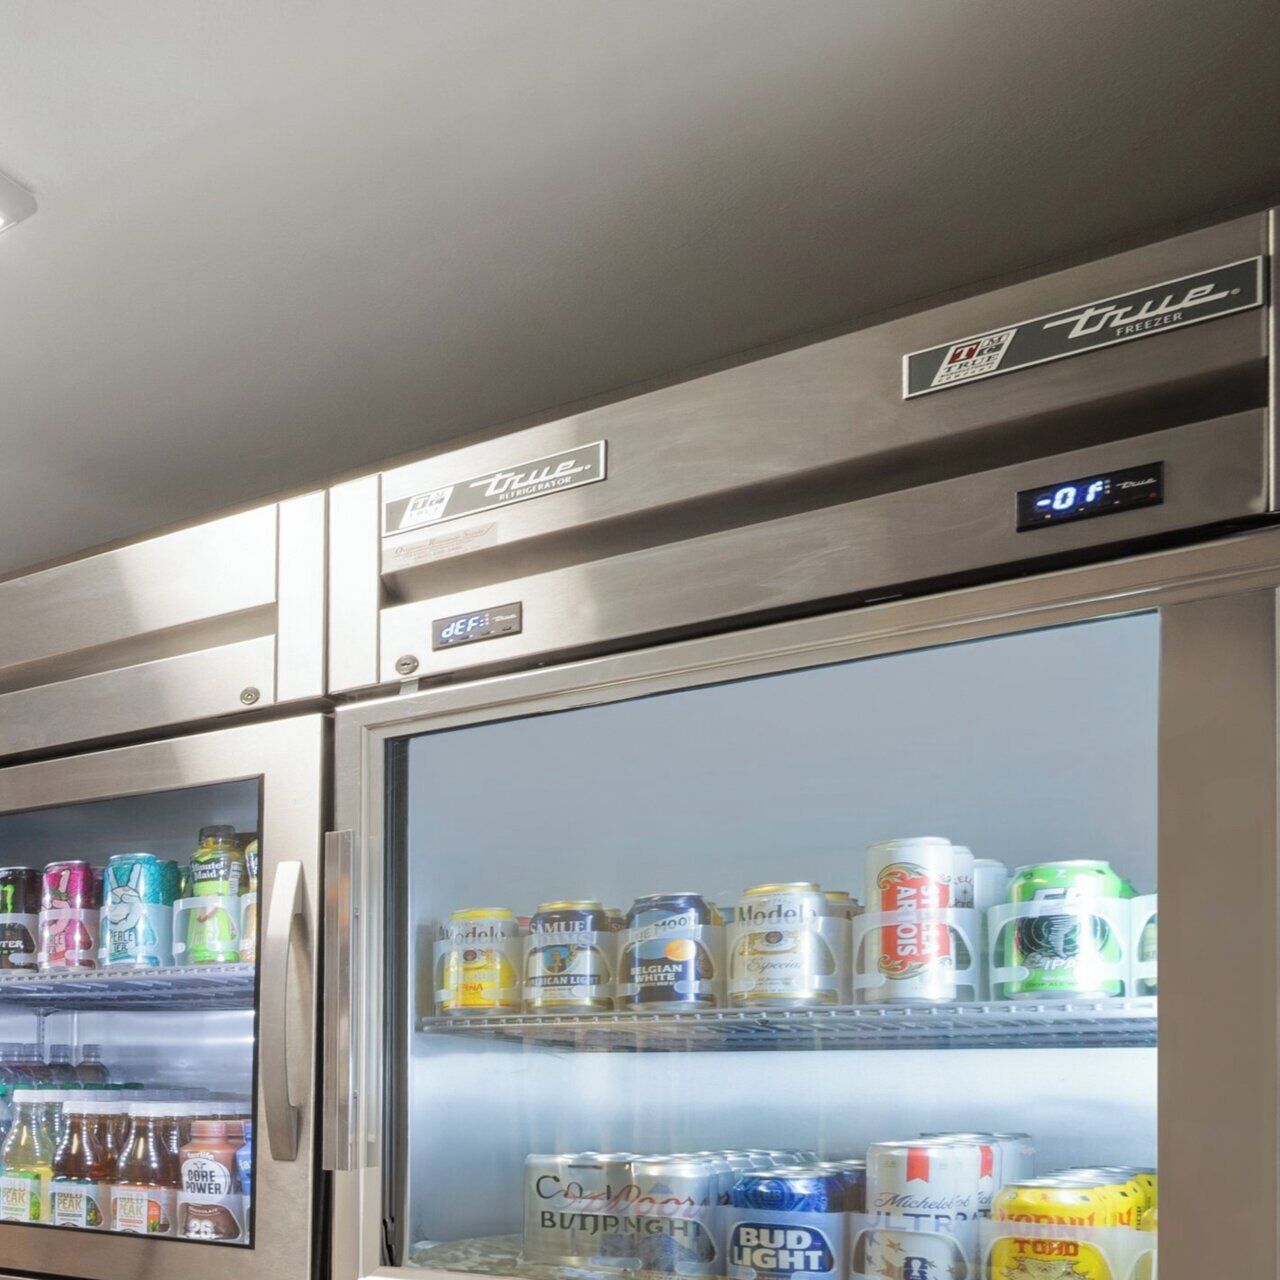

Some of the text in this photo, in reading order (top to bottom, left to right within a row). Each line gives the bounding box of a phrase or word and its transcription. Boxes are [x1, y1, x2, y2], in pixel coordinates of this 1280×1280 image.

[1116, 311, 1184, 337] FREEZER
[944, 352, 1000, 373] TRUE
[499, 475, 572, 501] REFRIGERATOR
[193, 870, 217, 882] Maid
[739, 906, 817, 928] Modelo
[896, 885, 914, 957] ARTOIS
[444, 926, 506, 945] Modelo
[529, 919, 592, 936] SAMUEL
[634, 972, 677, 984] WHITE
[186, 1169, 216, 1183] CORE
[1, 1188, 26, 1204] PEAK
[184, 1180, 222, 1195] POWER
[56, 1197, 83, 1211] PEAK
[119, 1203, 143, 1218] PEAK
[189, 1218, 214, 1237] 26
[740, 1227, 813, 1250] BUD
[734, 1248, 823, 1270] LIGHT
